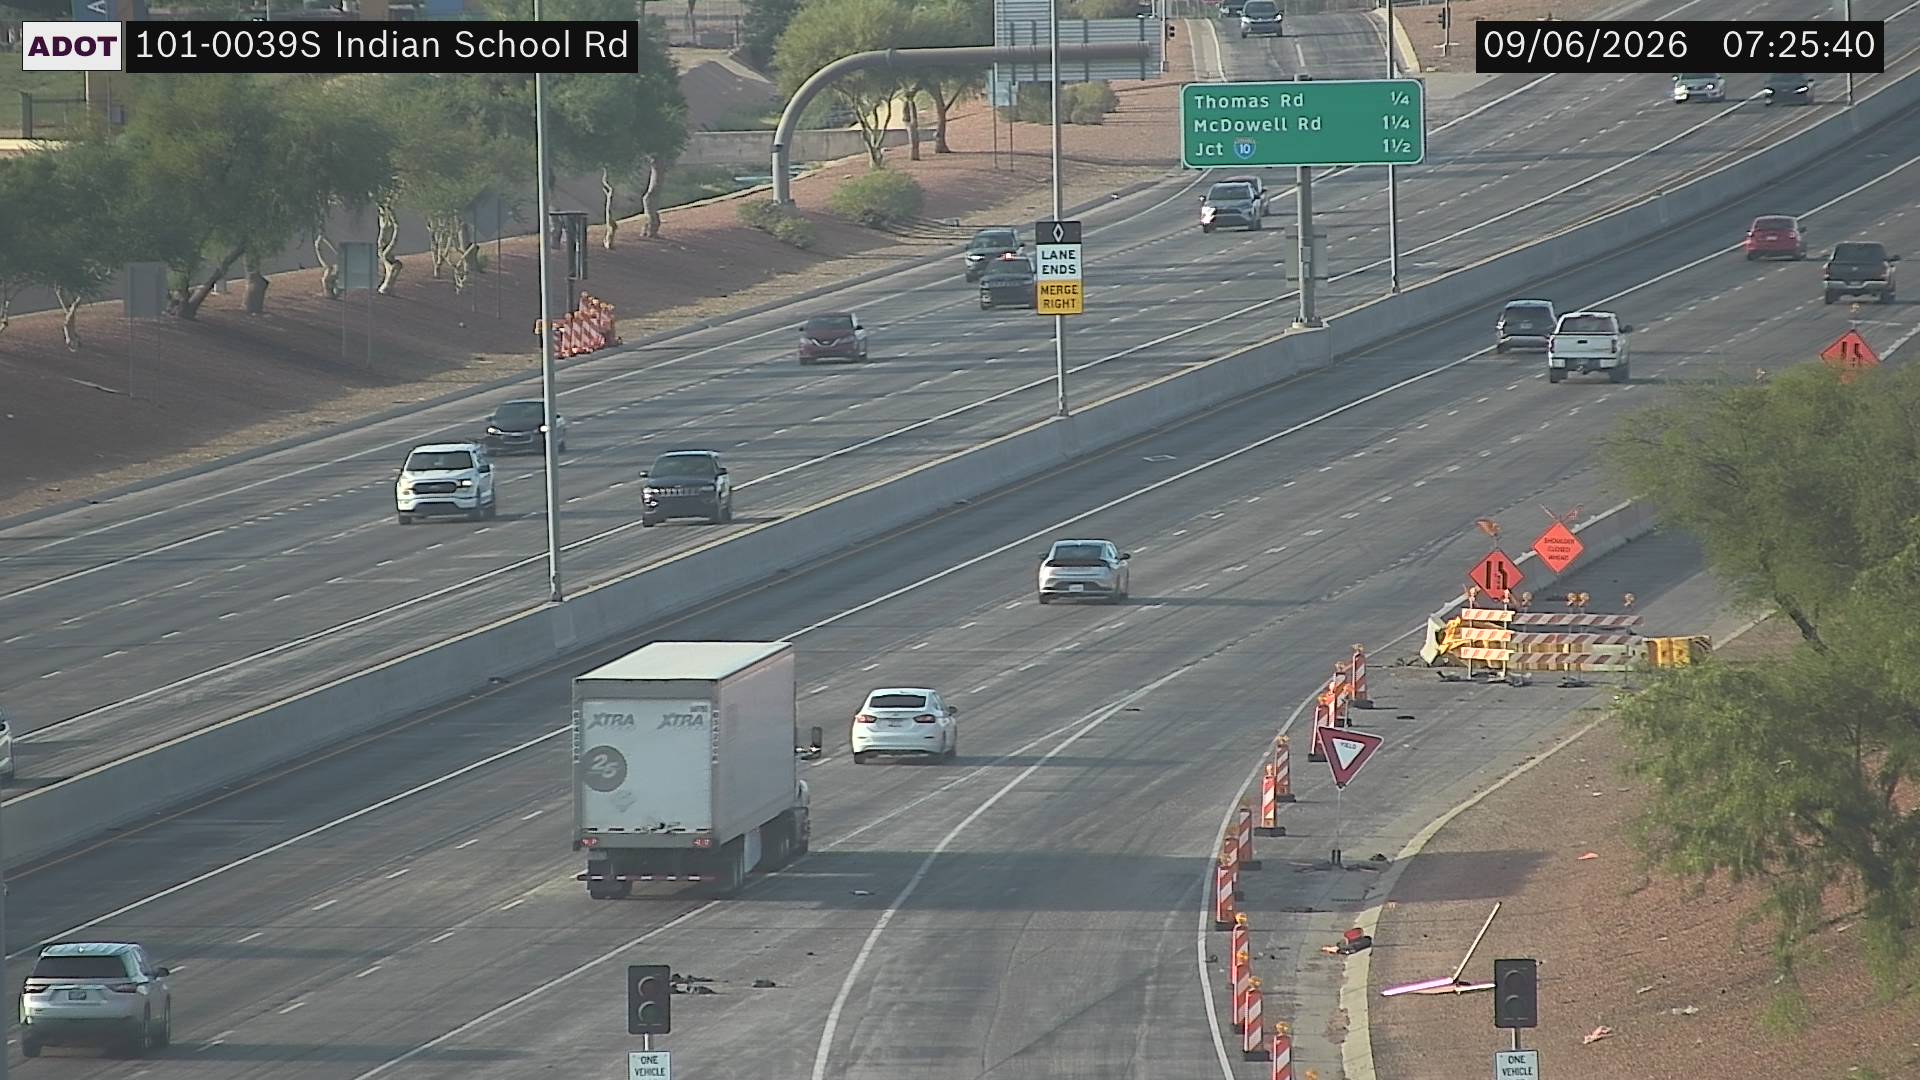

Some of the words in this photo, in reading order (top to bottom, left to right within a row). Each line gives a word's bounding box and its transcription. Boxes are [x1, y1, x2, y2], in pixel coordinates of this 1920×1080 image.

[1194, 95, 1269, 109] Thomas
[1280, 93, 1304, 108] Rd
[1194, 118, 1288, 133] McDowell
[1298, 117, 1322, 131] Rd
[1195, 142, 1224, 157] Jct
[1240, 143, 1251, 154] 10
[1041, 250, 1076, 260] LANE
[1042, 265, 1076, 274] ENDS
[1040, 285, 1078, 295] MERGE
[1043, 299, 1075, 308] RIGHT
[587, 712, 635, 730] XTRA
[656, 712, 704, 730] XTRA
[641, 1056, 658, 1064] ONE
[1508, 1055, 1526, 1064] ONE
[634, 1068, 665, 1076] VEHICLE
[1502, 1067, 1533, 1076] VEHICLE
